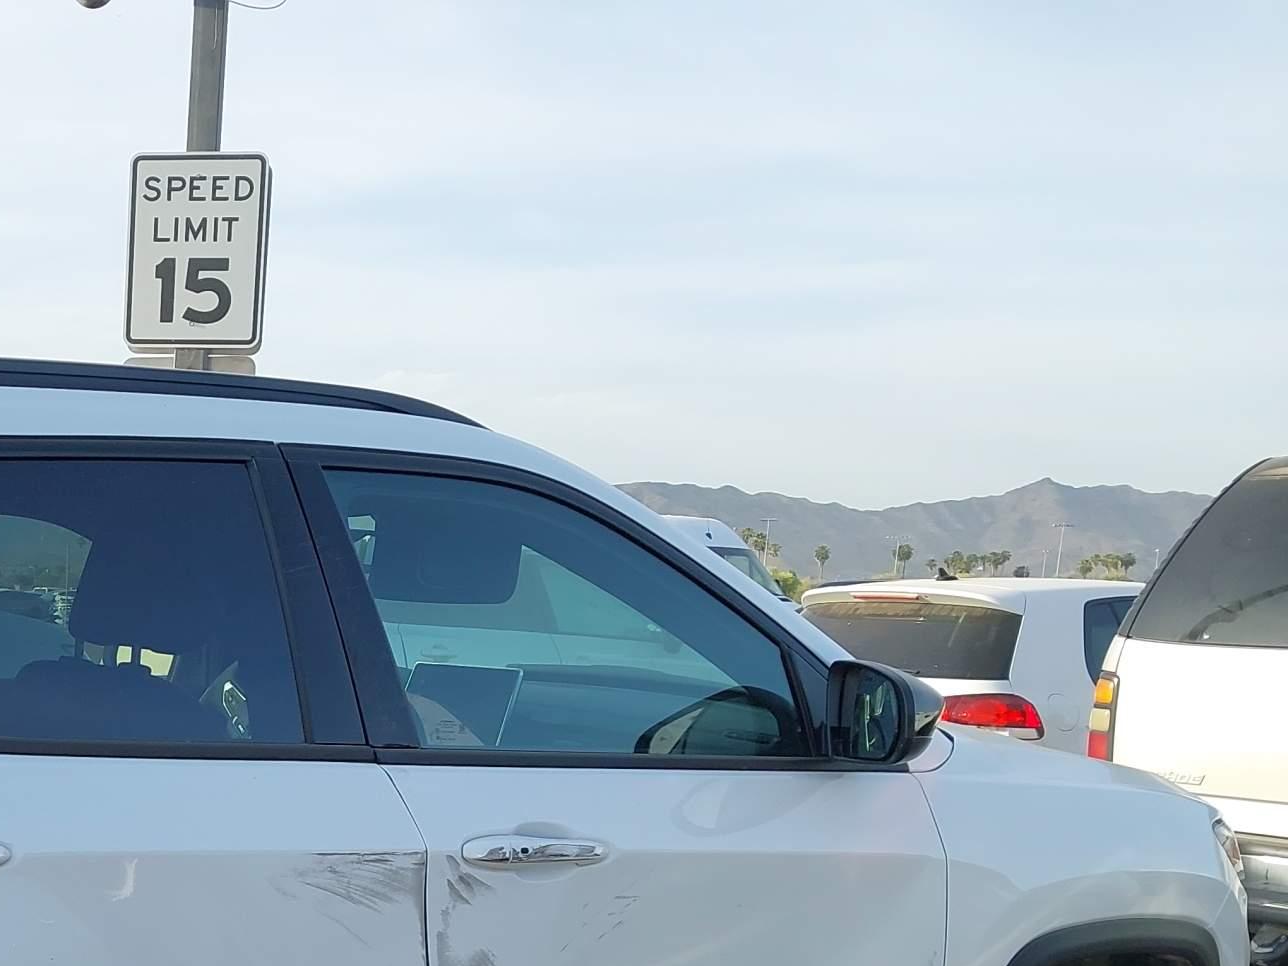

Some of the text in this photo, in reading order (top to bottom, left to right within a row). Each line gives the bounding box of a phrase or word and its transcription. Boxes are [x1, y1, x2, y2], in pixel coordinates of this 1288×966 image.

[142, 175, 255, 202] SPEED
[153, 216, 239, 242] LIMIT
[155, 257, 232, 324] 15
